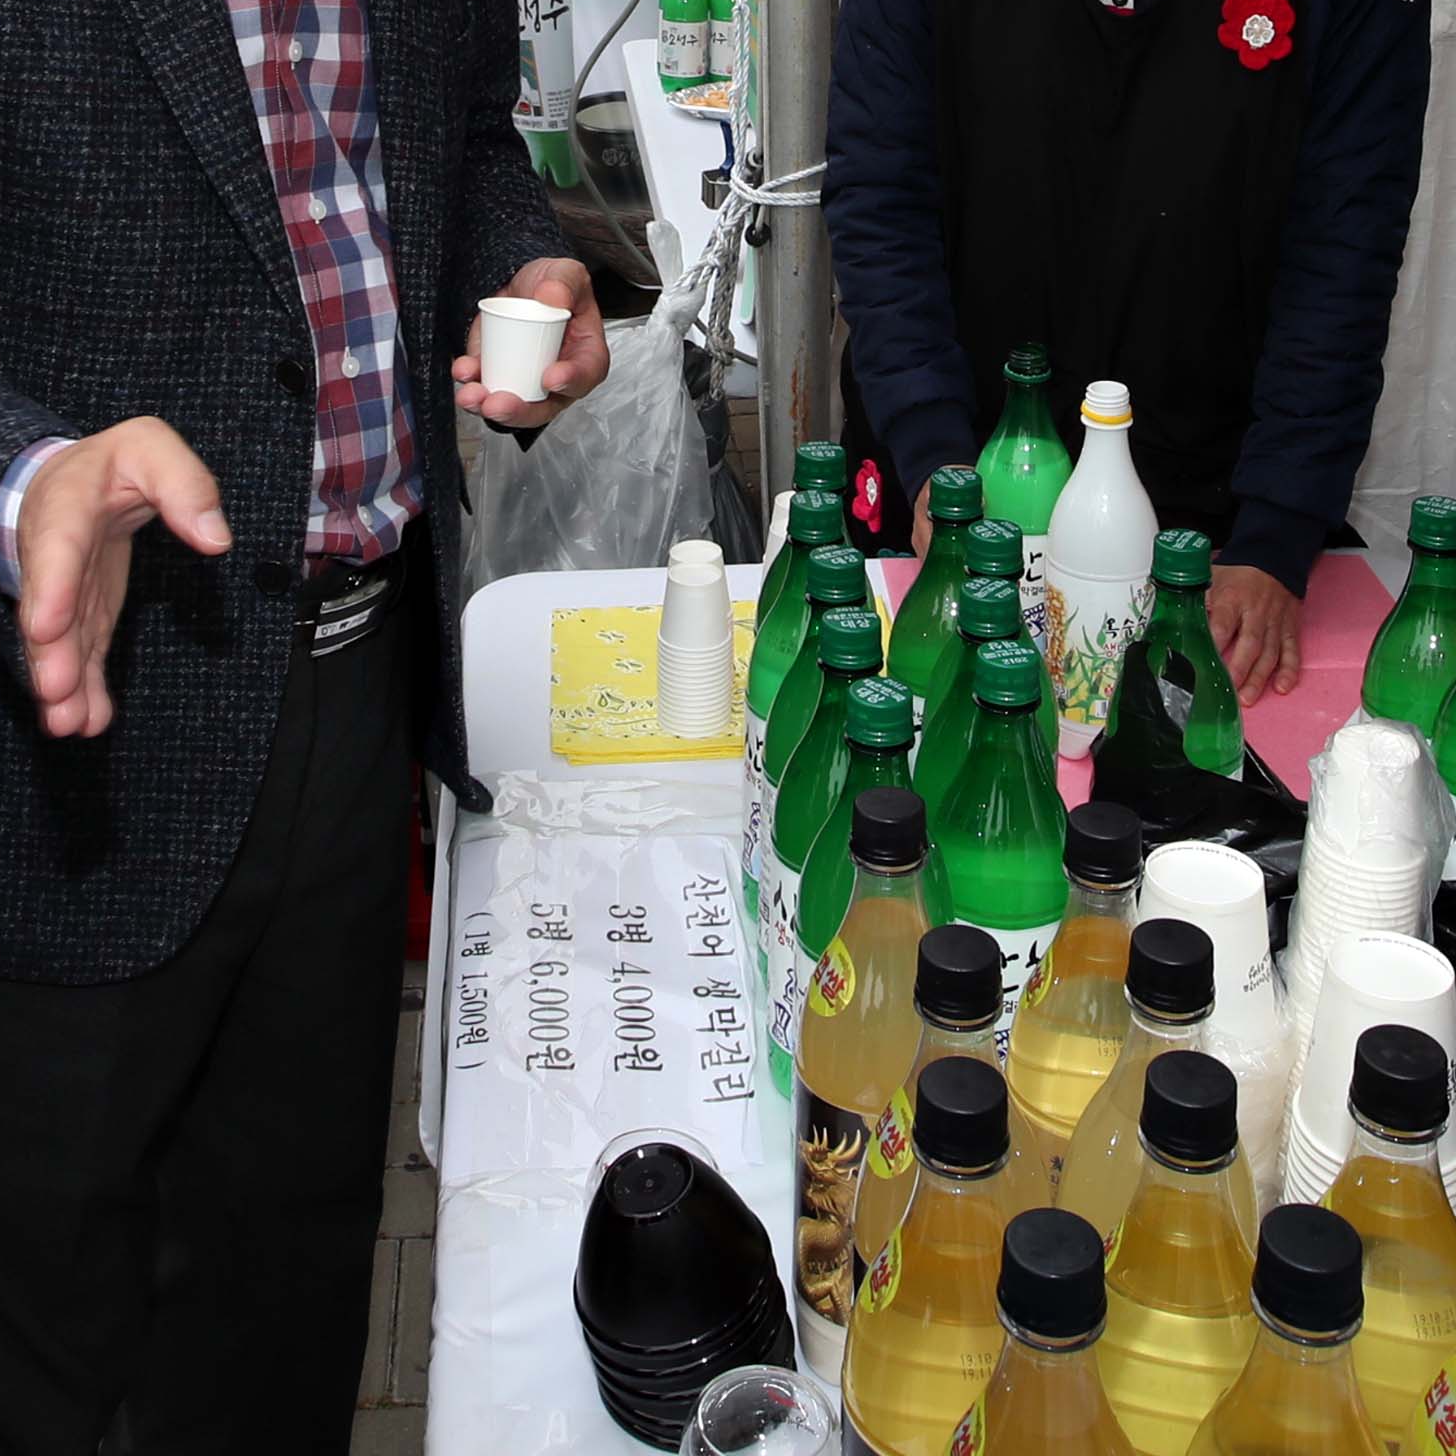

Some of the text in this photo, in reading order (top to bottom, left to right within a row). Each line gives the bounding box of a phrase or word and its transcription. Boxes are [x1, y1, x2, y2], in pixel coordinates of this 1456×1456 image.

[455, 971, 491, 1051] 1,500원
[463, 930, 493, 958] 1병
[525, 902, 576, 1074] 5병 6,000원
[607, 903, 664, 1073] 3병 4,000원
[681, 873, 756, 1104] 산천어 생막걸리
